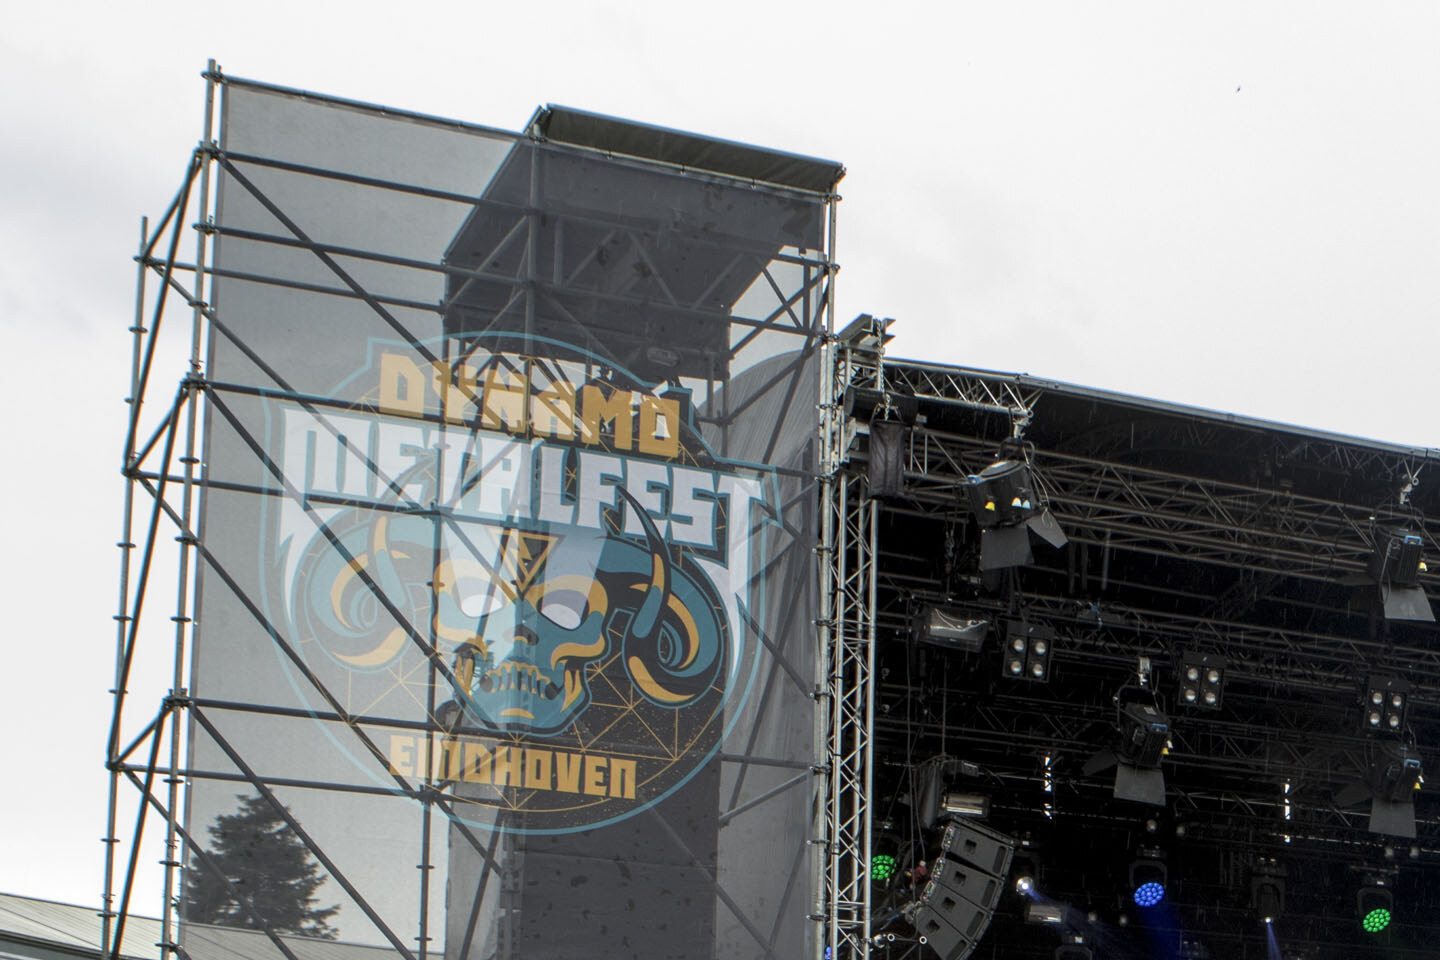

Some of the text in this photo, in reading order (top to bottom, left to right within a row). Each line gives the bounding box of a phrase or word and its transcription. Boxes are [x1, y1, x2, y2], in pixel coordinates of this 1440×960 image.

[380, 352, 680, 459] DYNAMO
[279, 406, 766, 598] METALFEST
[389, 734, 637, 801] EINDHOVEN
